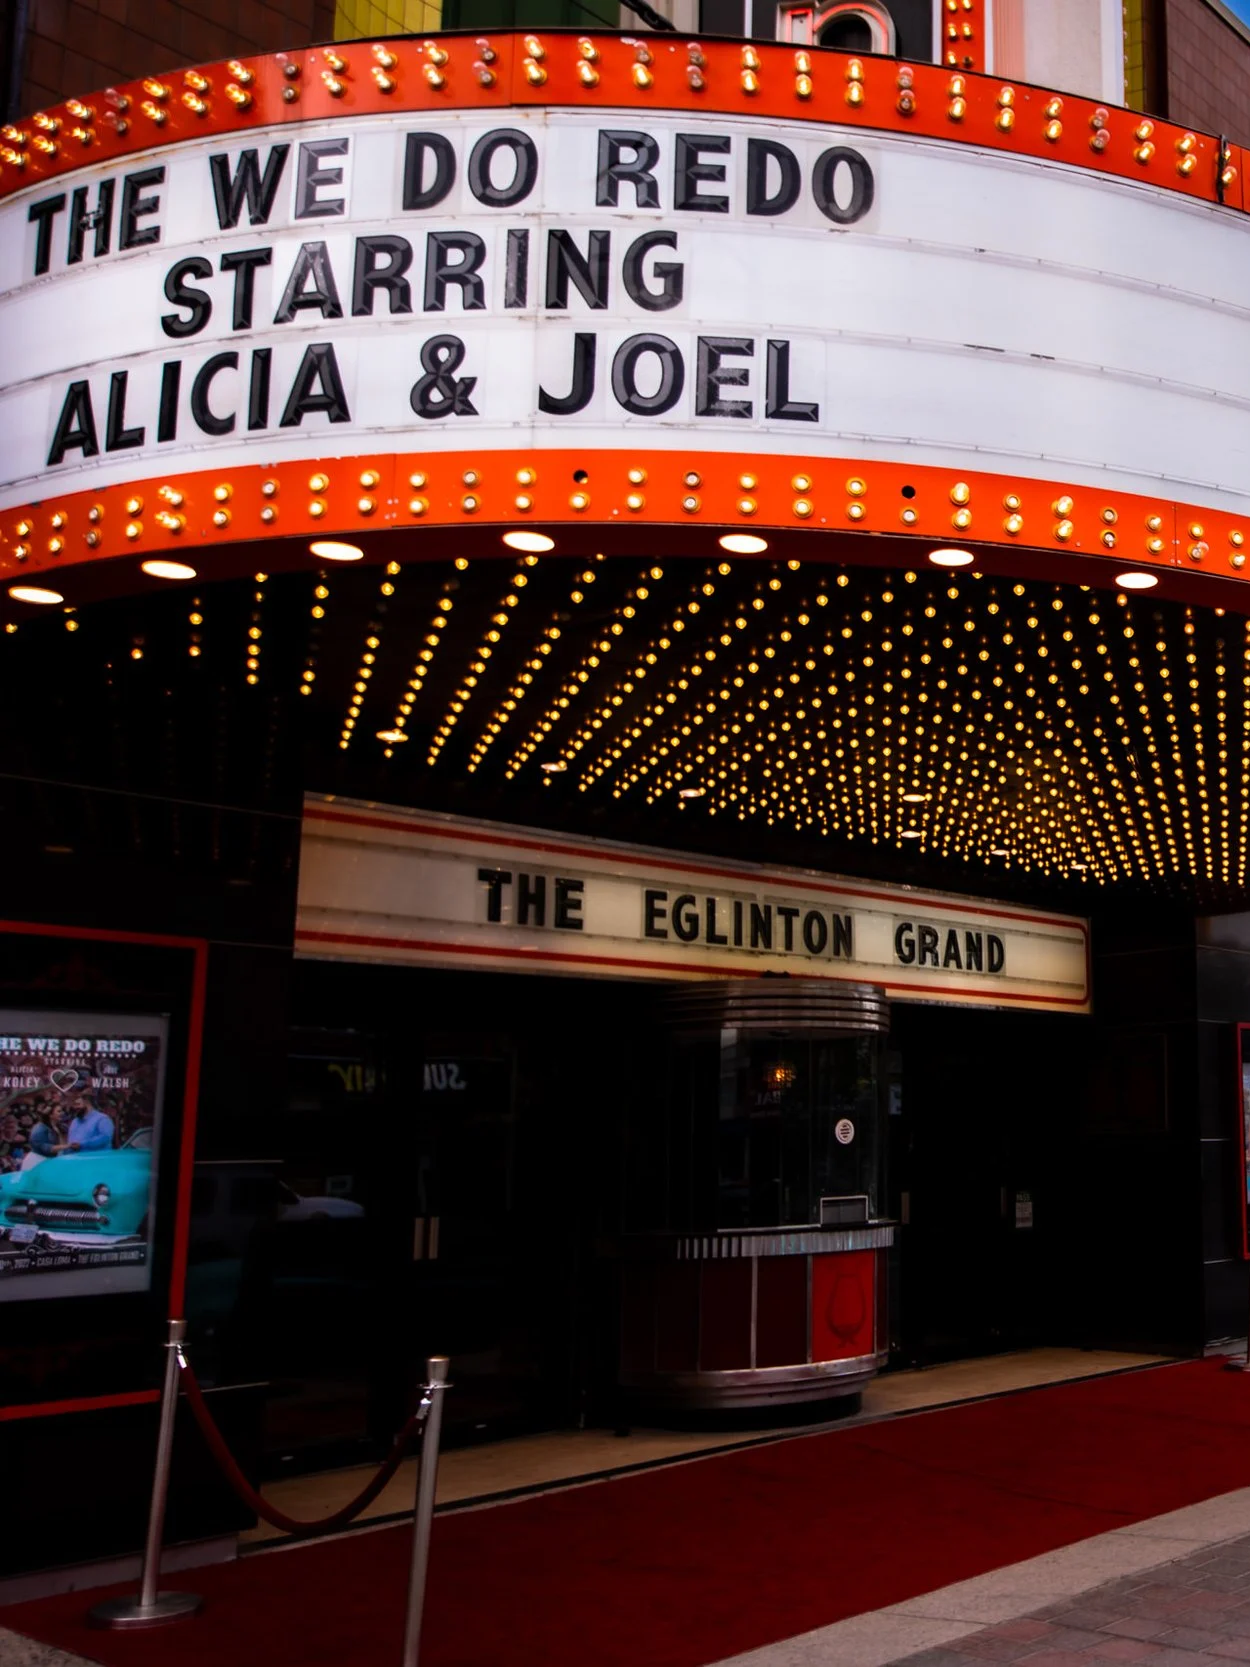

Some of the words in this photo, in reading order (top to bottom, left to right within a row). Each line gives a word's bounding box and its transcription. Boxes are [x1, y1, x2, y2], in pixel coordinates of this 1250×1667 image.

[28, 166, 166, 276] THE
[210, 137, 350, 231] WE
[402, 128, 539, 212] DO
[595, 128, 876, 224] REDO
[161, 228, 684, 339] STARRING
[46, 342, 351, 467] ALICIA
[410, 334, 479, 420] &
[538, 332, 820, 423] JOEL
[477, 868, 584, 931] THE
[644, 889, 854, 959] EGLINTON
[895, 922, 1006, 975] GRAND
[0, 1037, 21, 1051] HE
[27, 1038, 60, 1051] WE
[65, 1039, 91, 1052] DO
[96, 1040, 145, 1053] REDO
[3, 1076, 40, 1088] KOLEY
[92, 1077, 129, 1089] WALSH
